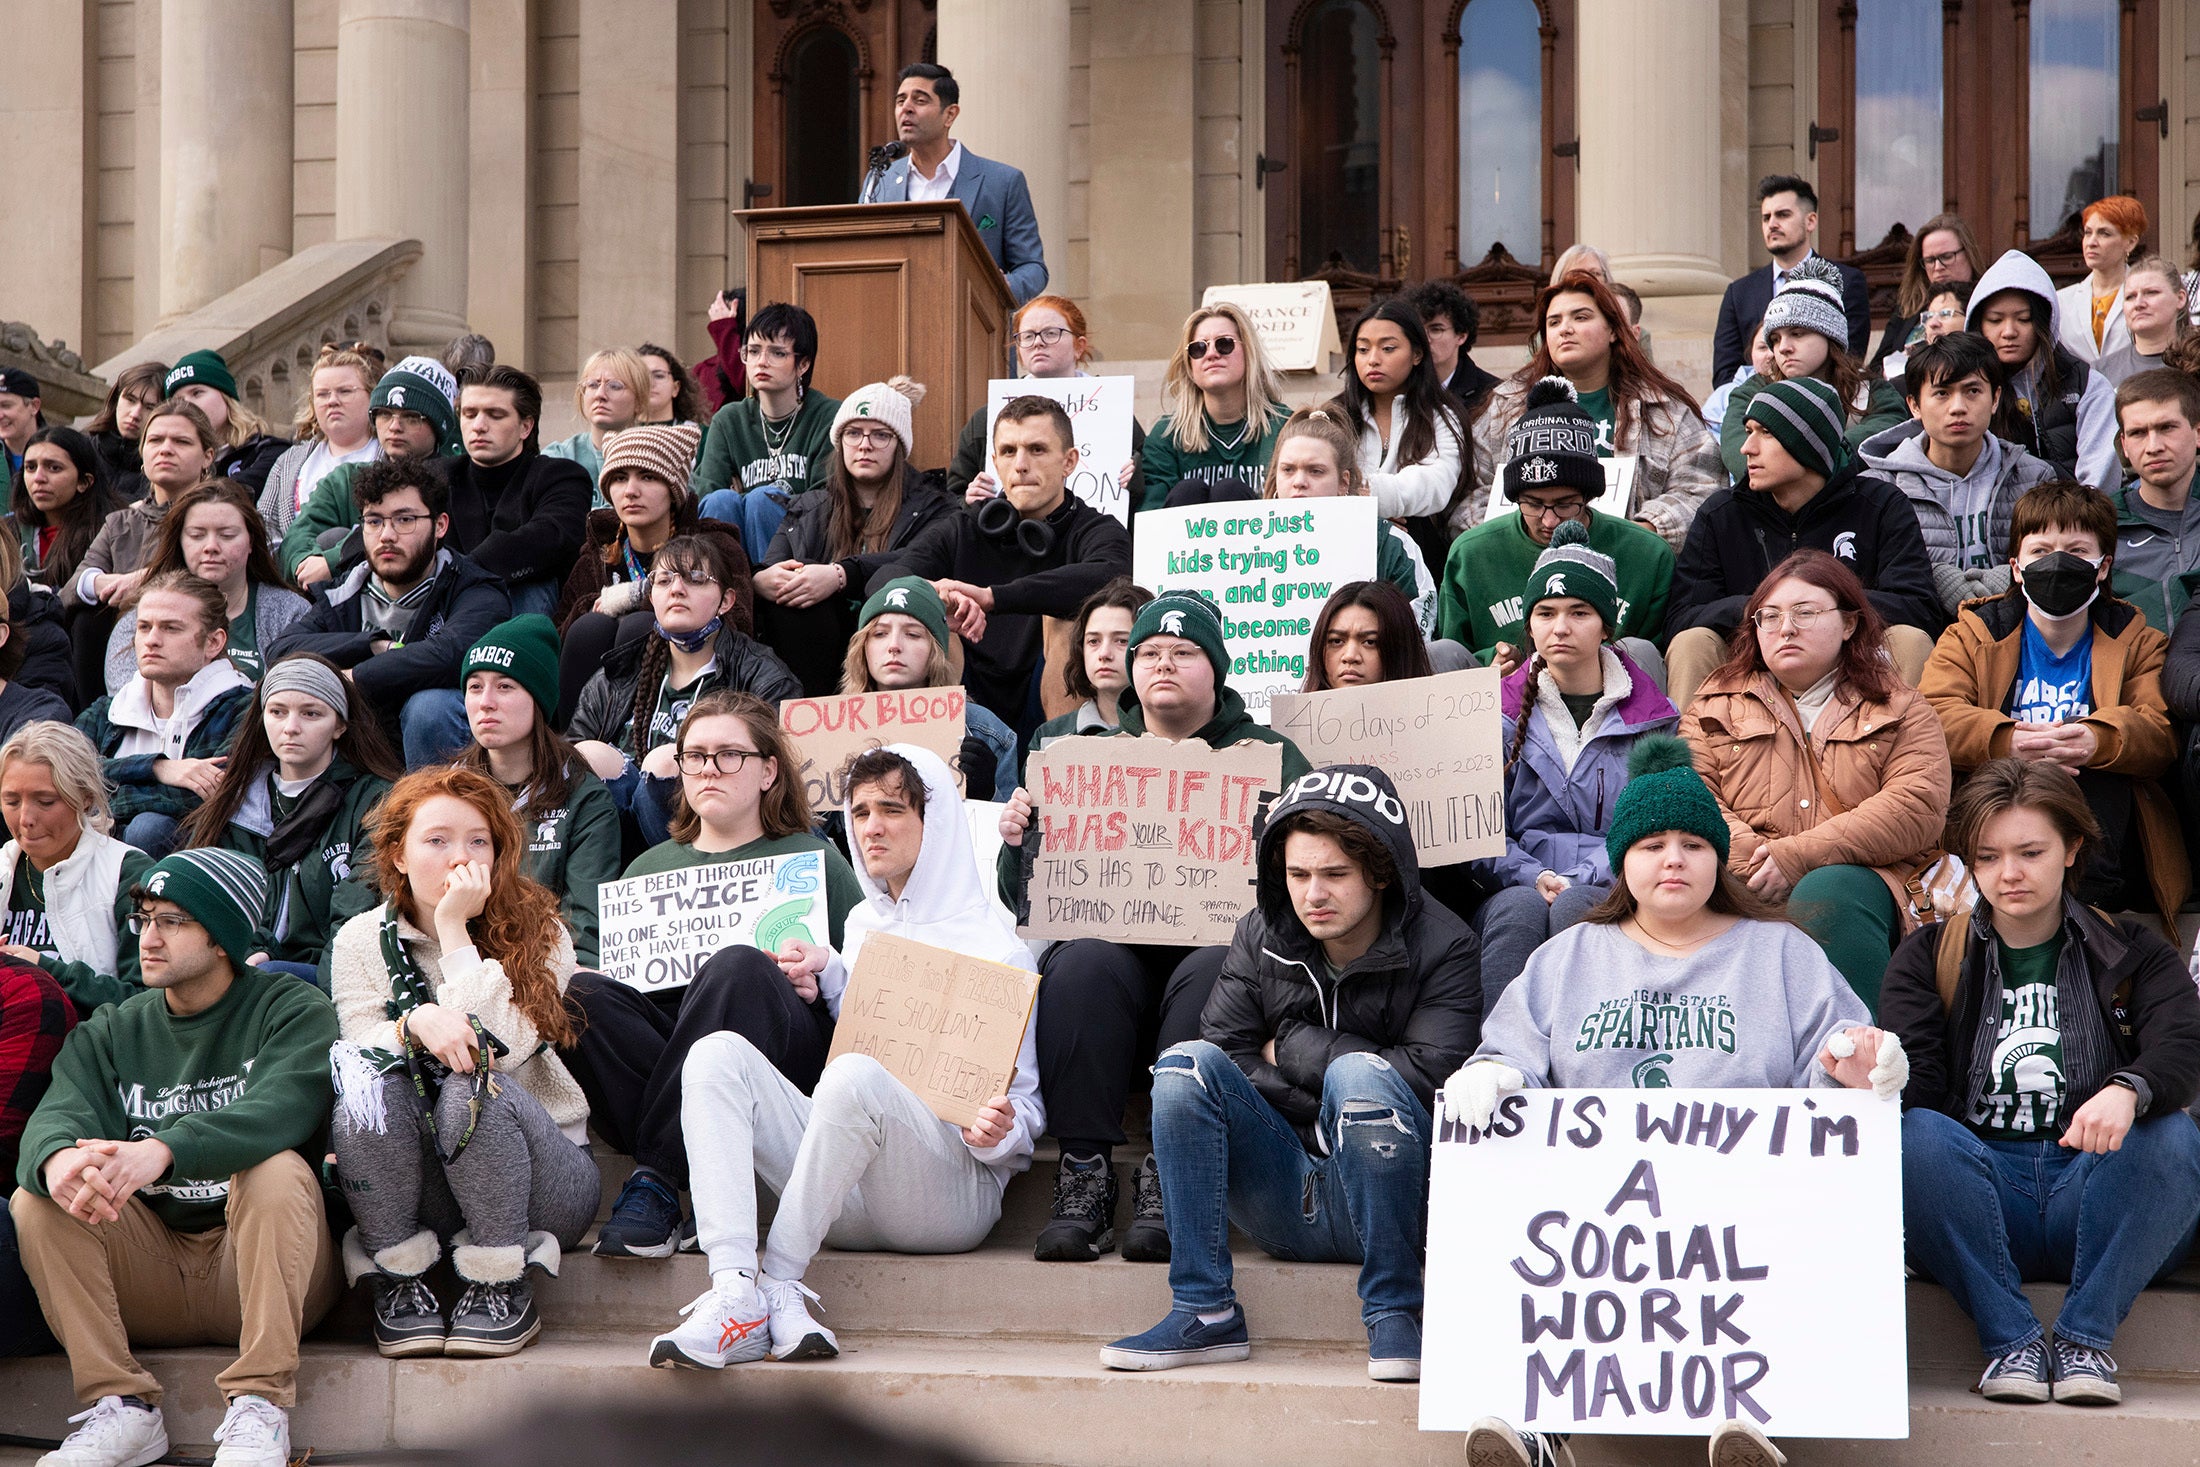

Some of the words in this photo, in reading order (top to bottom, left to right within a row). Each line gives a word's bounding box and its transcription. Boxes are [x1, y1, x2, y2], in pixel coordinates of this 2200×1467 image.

[1185, 517, 1218, 539] We
[1223, 518, 1263, 536] are
[1263, 510, 1315, 539] just
[1167, 548, 1214, 575] kids
[1218, 545, 1288, 575] trying
[1293, 543, 1321, 566] to
[1225, 577, 1267, 604] and
[1223, 616, 1312, 640] become
[469, 646, 515, 668] SMBCG
[784, 698, 870, 737] OUR
[876, 691, 963, 729] BLOOD
[1284, 698, 1342, 746] 46
[1349, 703, 1407, 747] days
[1414, 693, 1436, 729] of
[1443, 691, 1496, 721] 2023
[1426, 763, 1445, 779] of
[1452, 753, 1494, 774] 2023
[1042, 764, 1162, 809] WHAT
[1167, 769, 1211, 813] IF
[1219, 774, 1268, 825] IT
[1043, 811, 1129, 853] WAS
[1130, 822, 1173, 847] YOUR
[1446, 796, 1459, 844] IT
[601, 881, 637, 901] I'VE
[644, 870, 688, 894] BEEN
[694, 858, 775, 884] THROUGH
[1043, 858, 1089, 892] THIS
[1099, 856, 1133, 889] HAS
[1143, 862, 1167, 889] TO
[1175, 865, 1218, 889] STOP.
[601, 898, 644, 919] THIS
[649, 878, 759, 917] TWICE
[1047, 894, 1116, 924] DEMAND
[1122, 898, 1187, 928] CHANGE.
[1200, 900, 1242, 911] SPARTAN
[601, 930, 623, 949] NO
[627, 923, 659, 944] ONE
[666, 911, 743, 937] SHOULD
[602, 945, 641, 965] EVER
[649, 937, 690, 956] HAVE
[694, 933, 720, 948] TO
[866, 941, 916, 983] This
[918, 961, 959, 995] isn't
[853, 985, 895, 1020] WE
[898, 997, 988, 1043] SHOULDN'T
[1575, 1003, 1737, 1055] SPARTANS
[900, 1042, 925, 1077] TO
[1547, 1095, 1607, 1148] IS
[1636, 1100, 1759, 1155] WHY
[1604, 1158, 1662, 1218] A
[1510, 1210, 1770, 1287] SOCIAL
[1521, 1287, 1751, 1346] WORK
[1524, 1348, 1772, 1425] MAJOR
